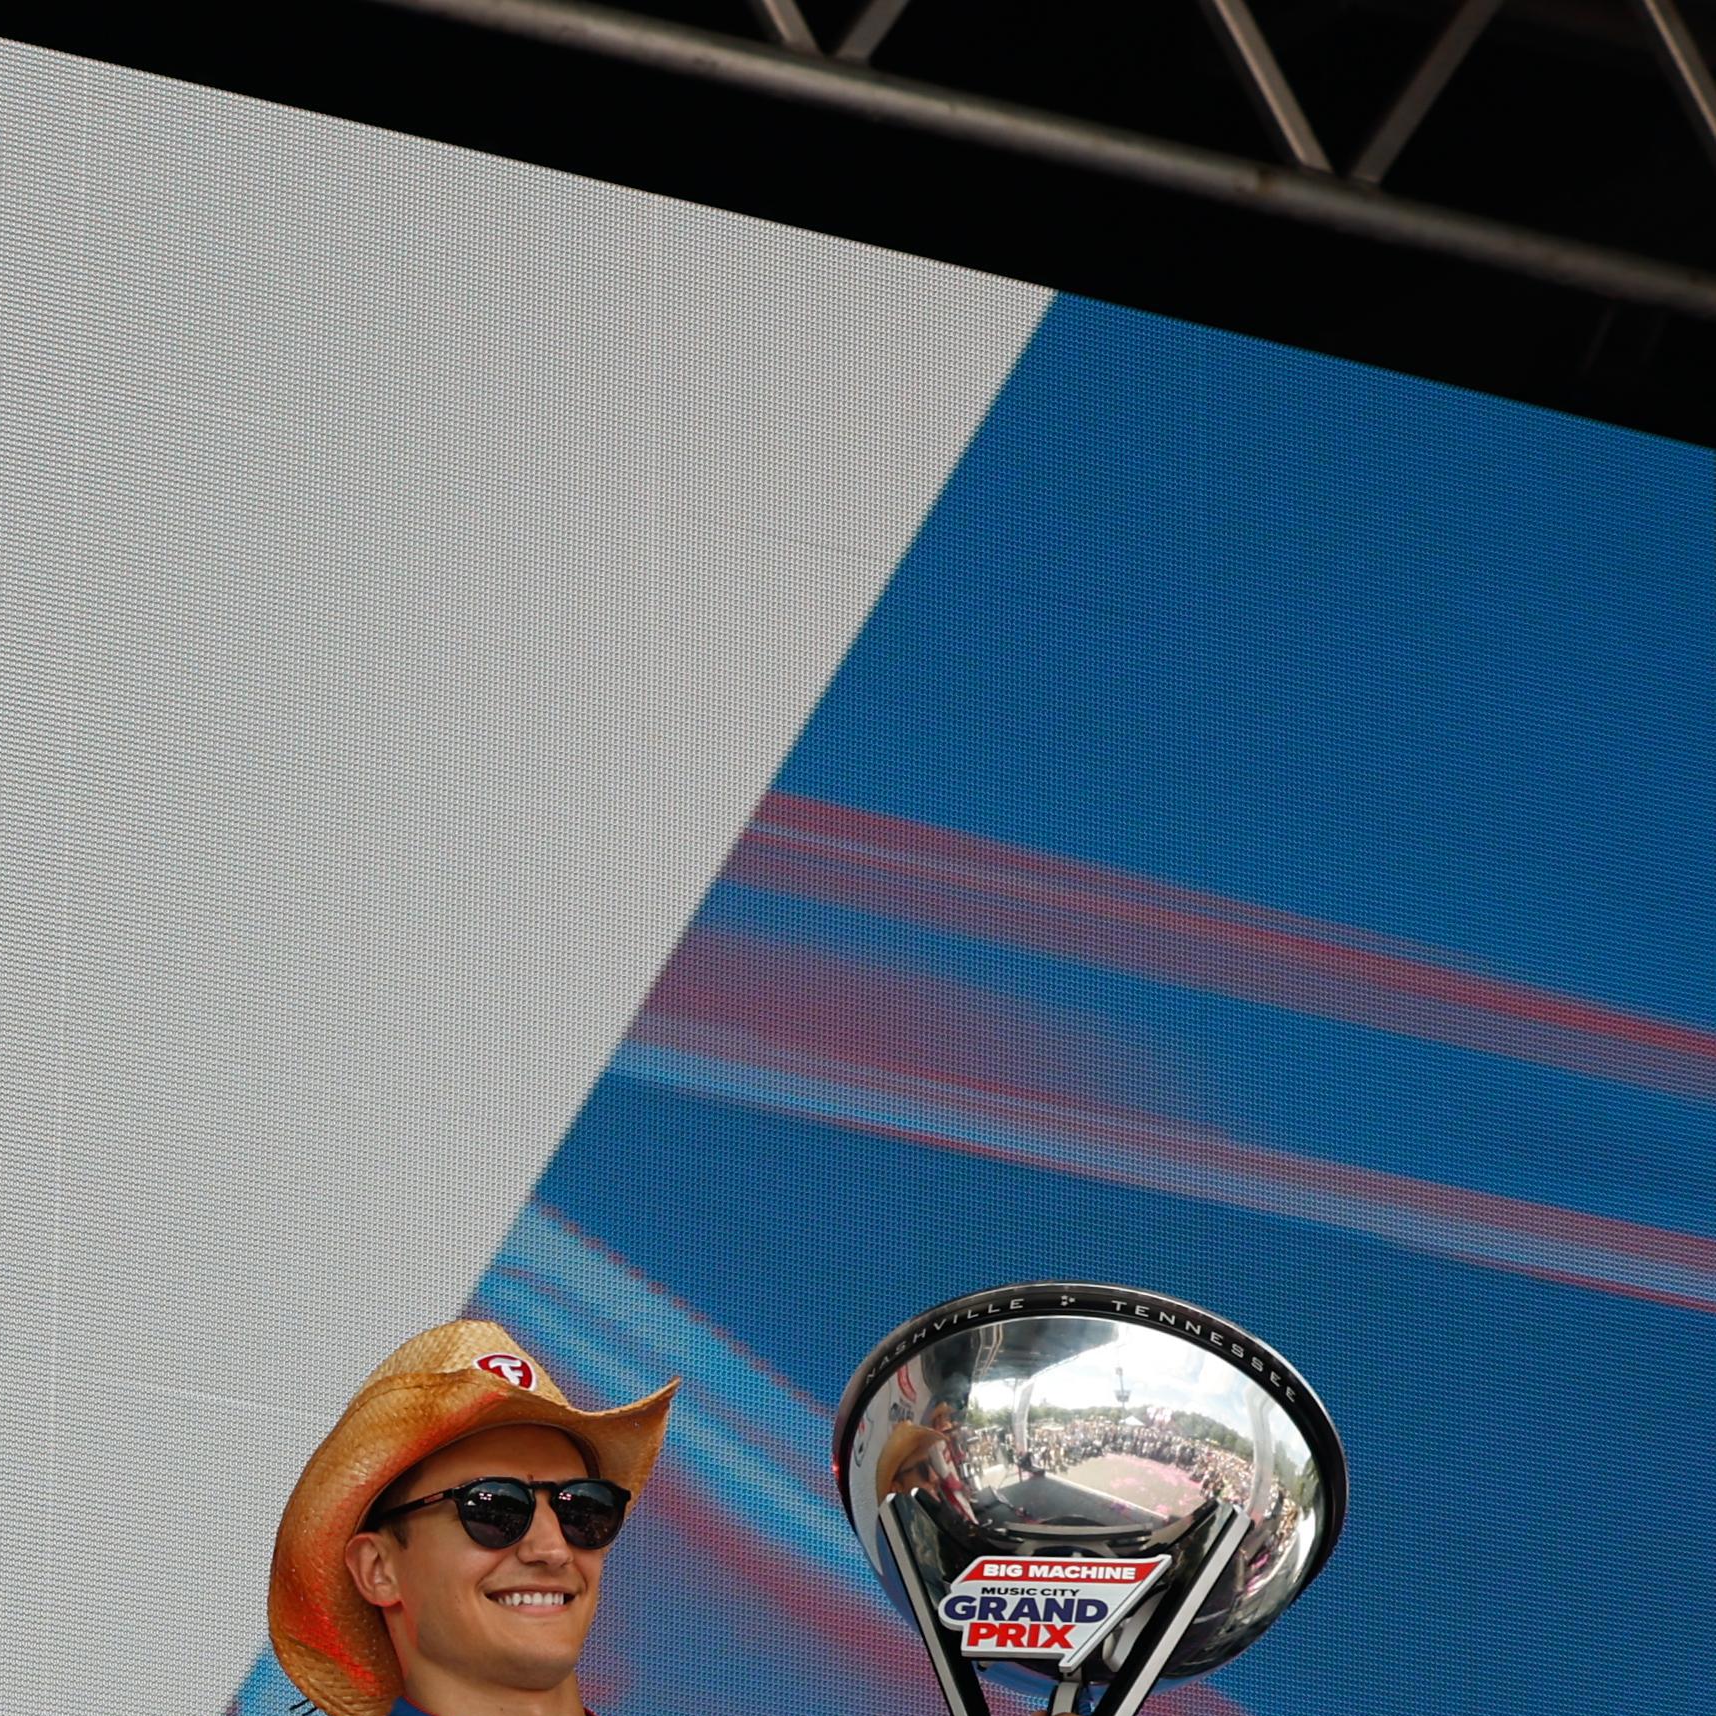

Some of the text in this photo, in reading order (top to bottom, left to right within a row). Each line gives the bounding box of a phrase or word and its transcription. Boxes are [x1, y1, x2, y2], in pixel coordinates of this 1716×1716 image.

[1110, 1299, 1296, 1403] TENNESSEE
[982, 1563, 1137, 1581] BIG MACHINE
[981, 1587, 1080, 1598] MUSIC CITY
[943, 1595, 1110, 1624] GRAND
[967, 1622, 1077, 1649] PRIX
